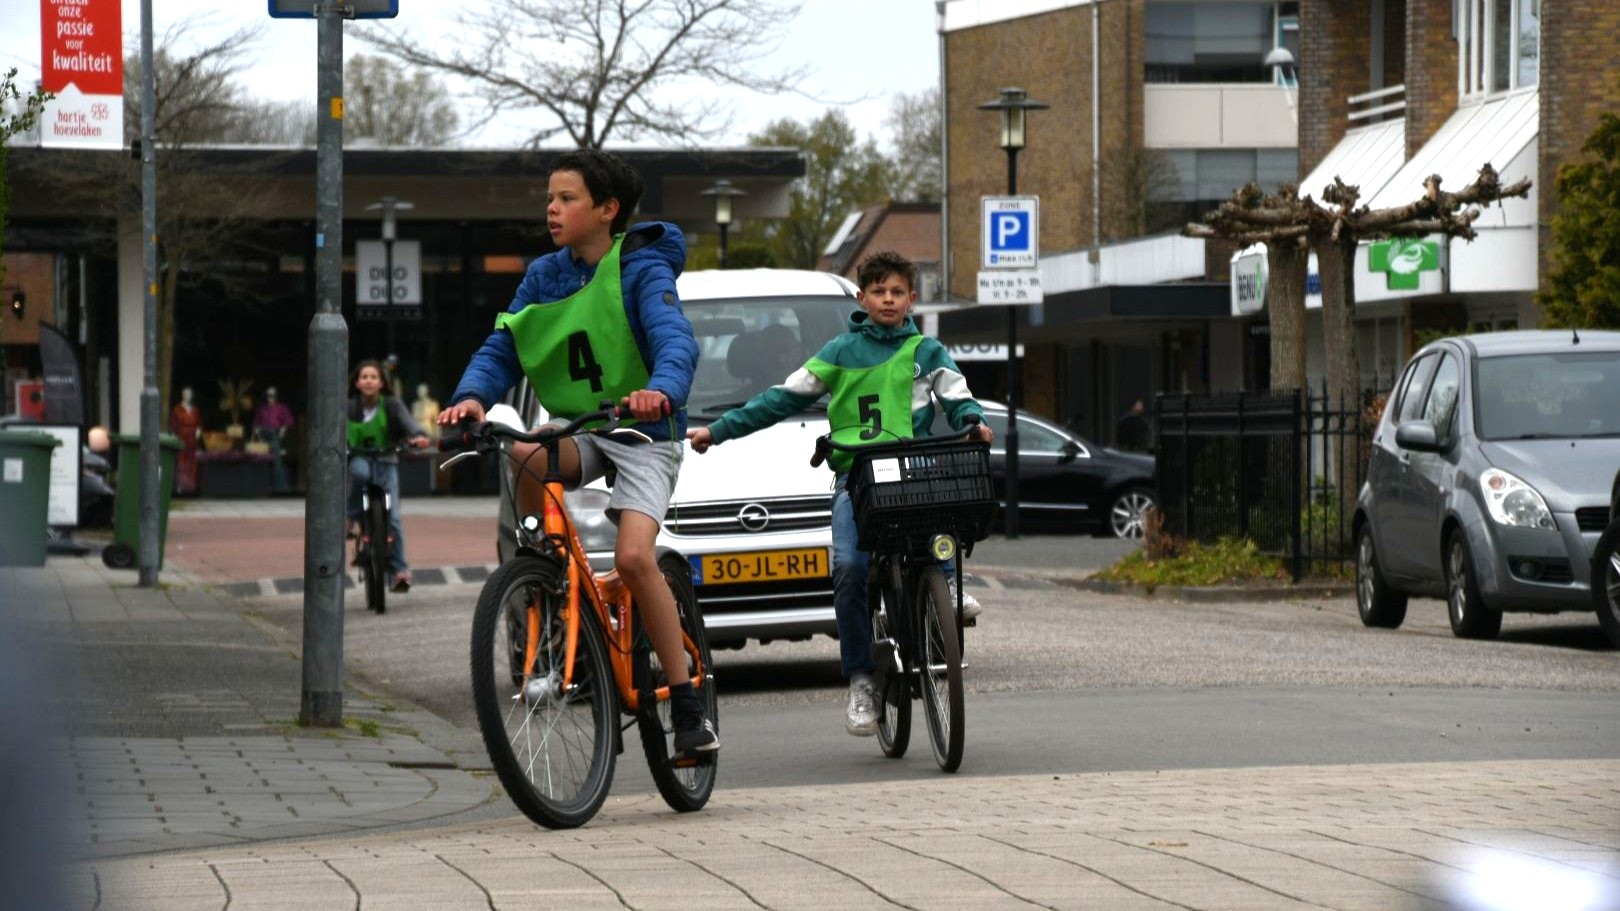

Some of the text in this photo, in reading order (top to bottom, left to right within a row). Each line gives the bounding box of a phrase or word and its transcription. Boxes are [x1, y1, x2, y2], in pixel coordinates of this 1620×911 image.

[58, 6, 81, 17] onze
[57, 18, 93, 38] passie
[65, 39, 84, 49] voor
[53, 49, 112, 73] kwaliteit
[57, 110, 86, 123] hartje
[54, 123, 102, 137] hoevelaken
[999, 215, 1021, 247] P
[1238, 272, 1256, 302] BENU
[568, 329, 603, 393] 4
[858, 393, 882, 441] 5
[711, 554, 818, 580] 30-JL-RH
